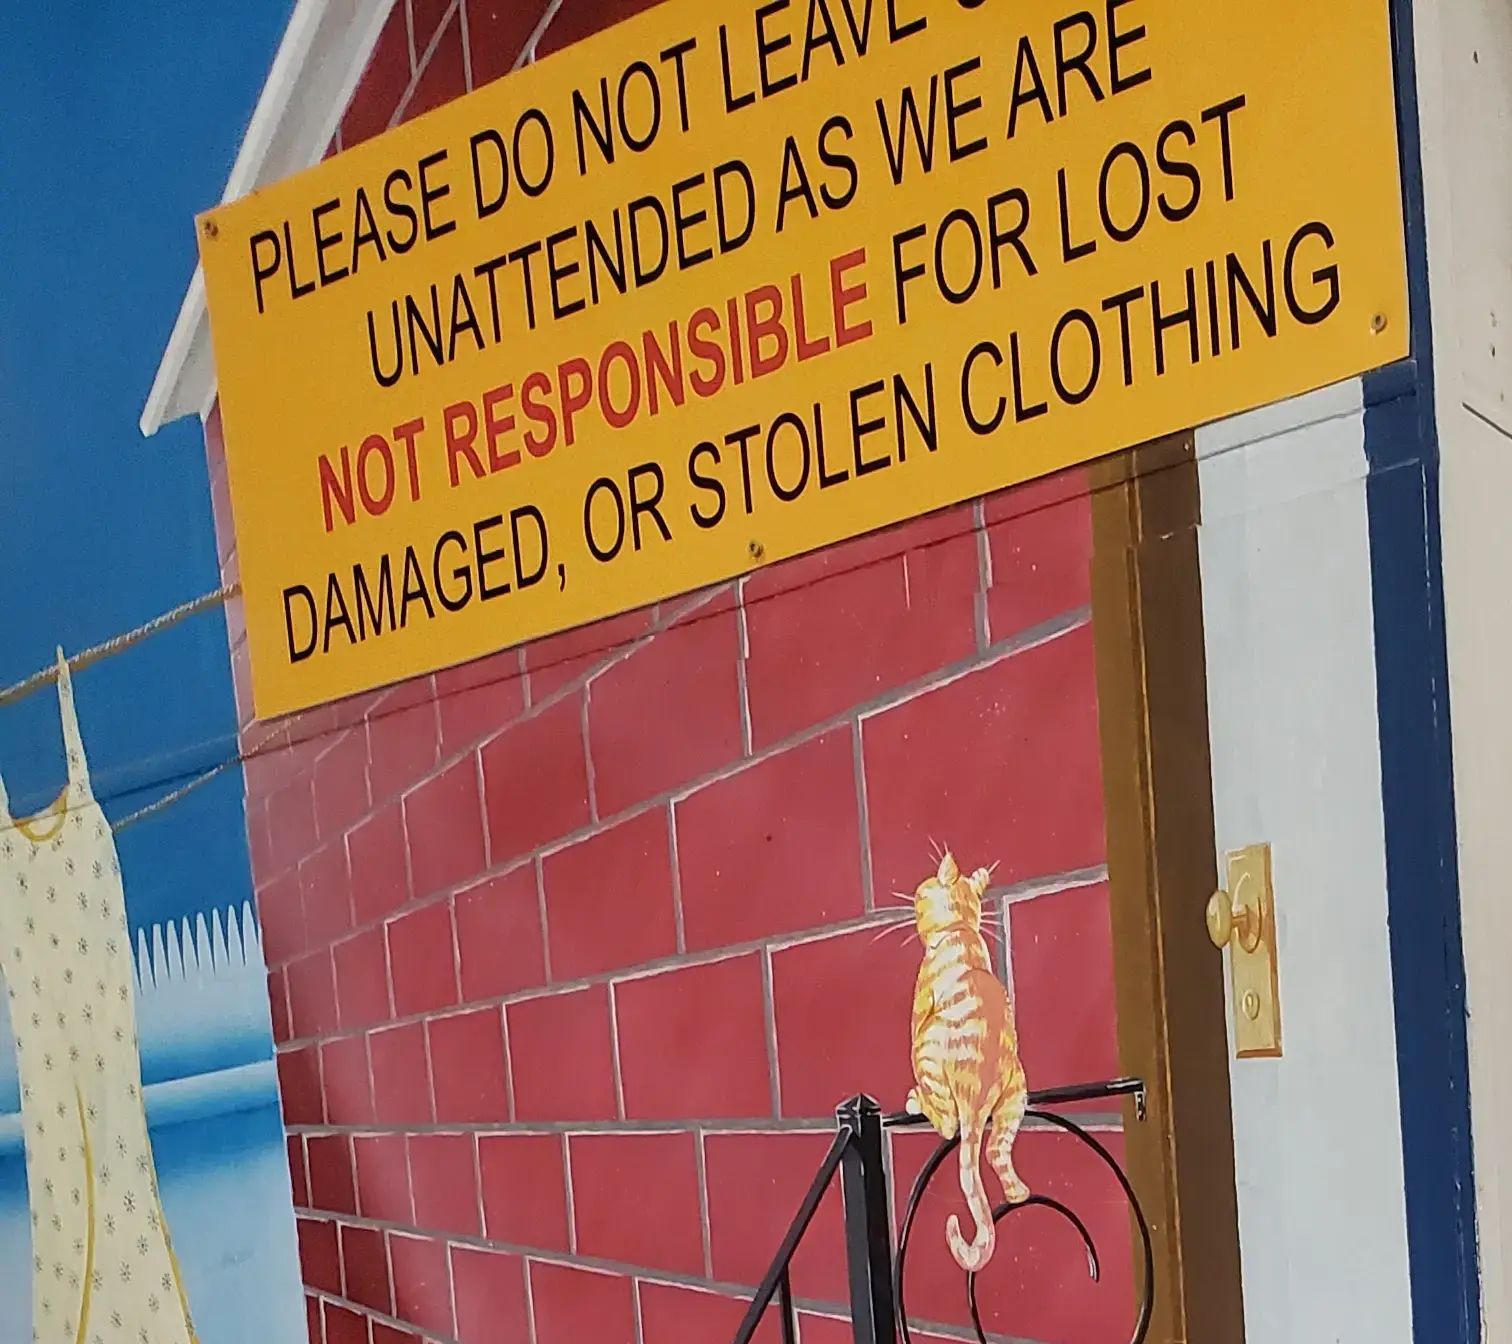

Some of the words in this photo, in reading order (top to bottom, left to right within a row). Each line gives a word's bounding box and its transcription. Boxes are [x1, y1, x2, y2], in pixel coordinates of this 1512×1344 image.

[250, 150, 456, 313] PLEASE
[471, 109, 553, 218] DO
[573, 38, 696, 174] NOT
[321, 420, 423, 530] NOT
[445, 251, 872, 483] RESPONSIBLE
[893, 189, 1037, 324] FOR
[1058, 95, 1245, 262] LOST
[368, 160, 755, 386] UNATTENDED
[777, 116, 857, 232] AS
[876, 57, 987, 185] WE
[1008, 0, 1151, 138] ARE
[284, 506, 566, 662] DAMAGED,
[585, 463, 671, 561] OR
[689, 363, 936, 528] STOLEN
[962, 222, 1339, 434] CLOTHING
